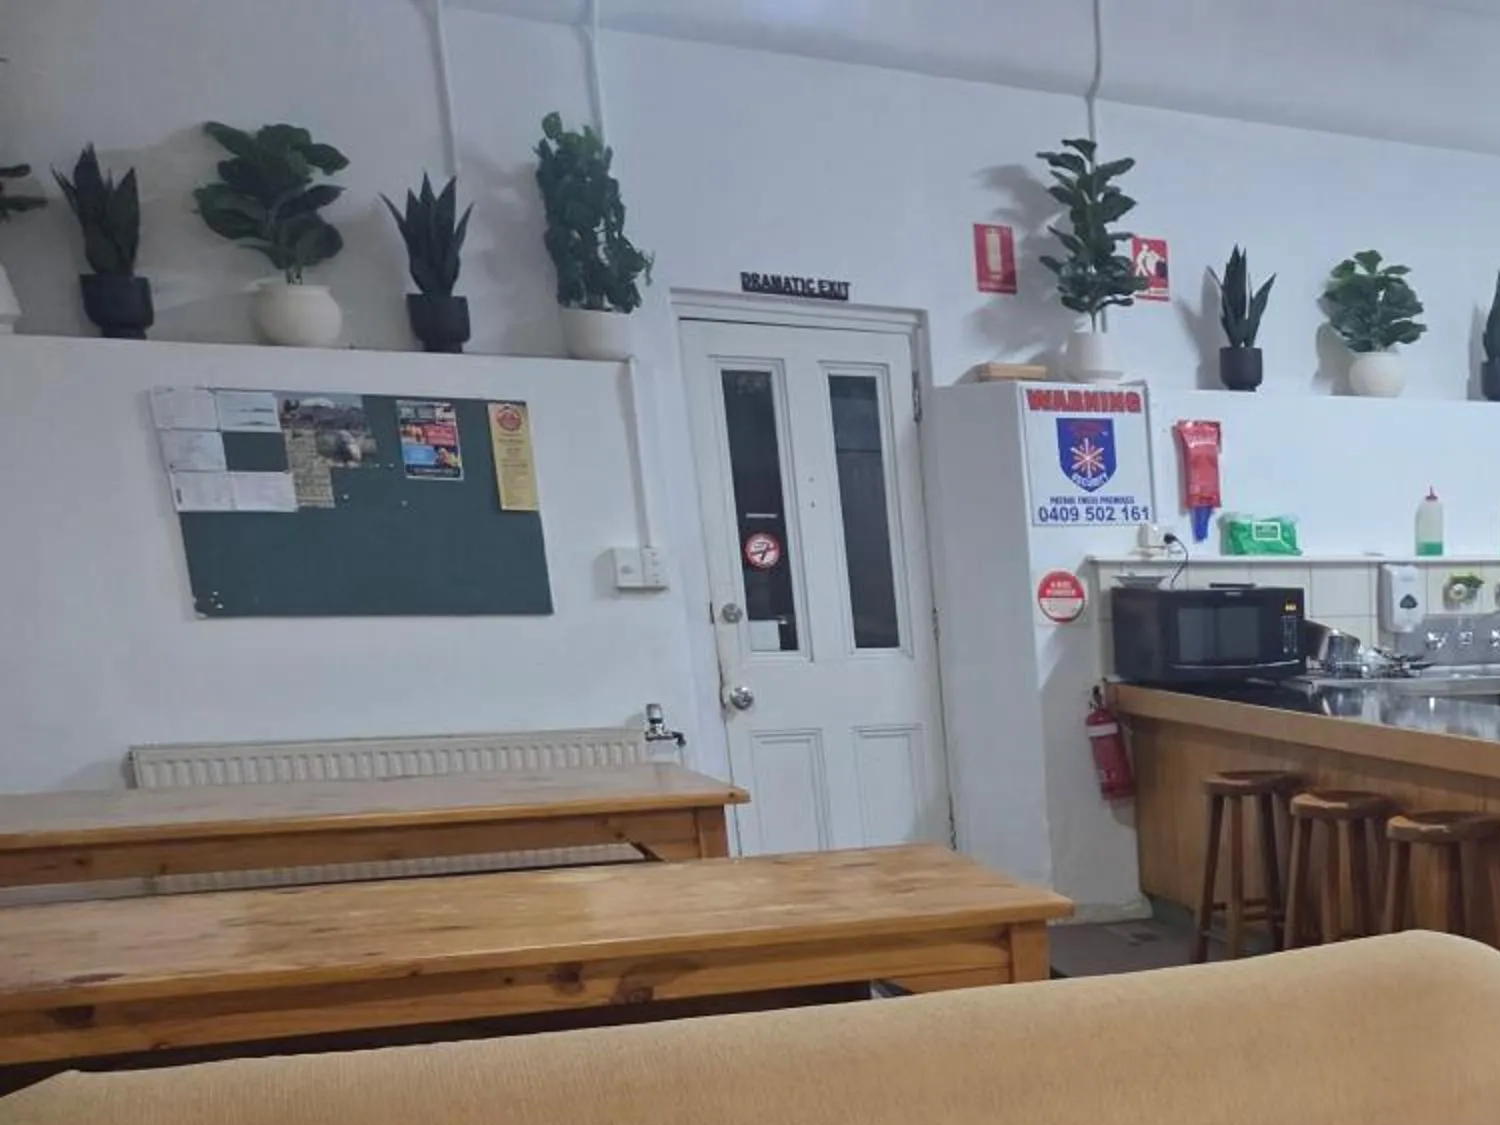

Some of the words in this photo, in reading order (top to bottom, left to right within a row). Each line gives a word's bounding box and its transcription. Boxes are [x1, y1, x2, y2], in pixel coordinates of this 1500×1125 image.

[740, 272, 816, 297] DRAMATIC
[818, 279, 850, 300] EXIT
[1026, 389, 1142, 413] WARNING
[1038, 506, 1080, 522] 0409
[1085, 507, 1117, 521] 502
[1121, 507, 1149, 521] 161
